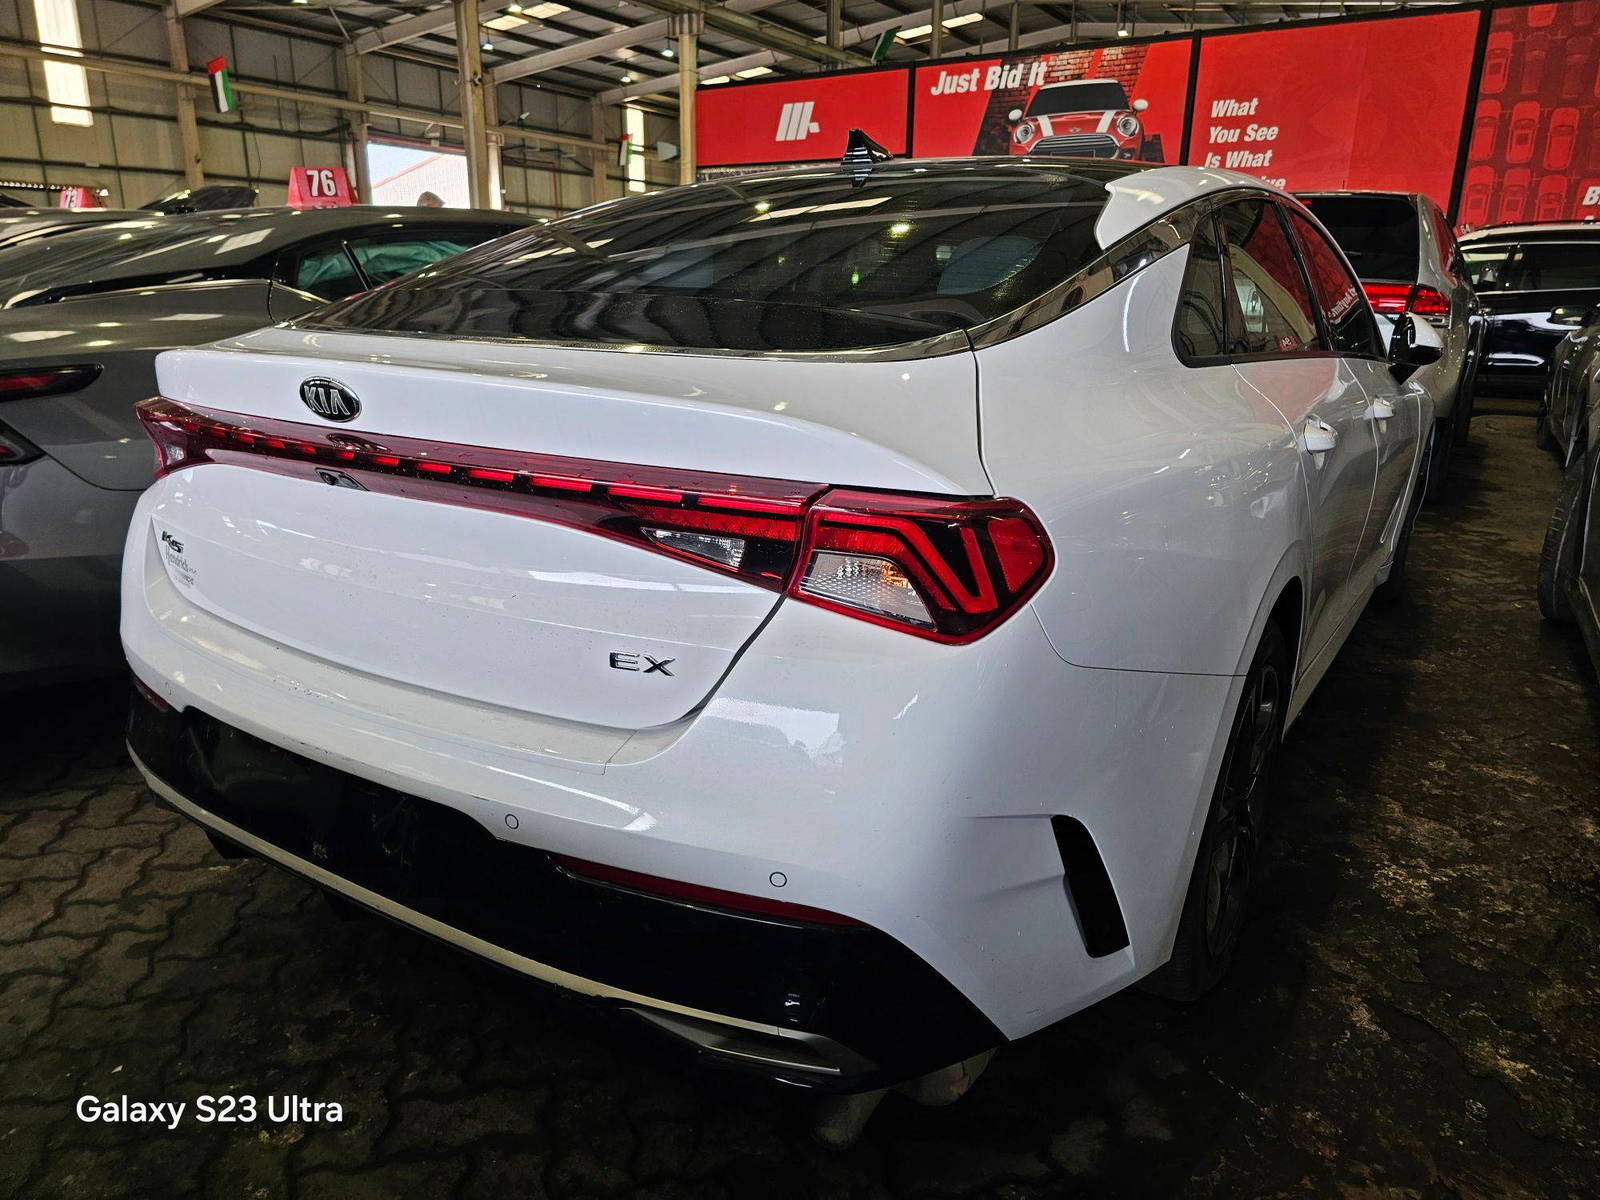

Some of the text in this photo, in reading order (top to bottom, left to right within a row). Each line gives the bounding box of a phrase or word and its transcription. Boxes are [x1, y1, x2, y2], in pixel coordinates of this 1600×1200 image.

[930, 60, 1047, 96] Just Bid It
[1211, 98, 1259, 118] What
[1209, 123, 1280, 144] You See
[1204, 149, 1273, 169] Is What
[306, 169, 337, 197] 76
[303, 385, 351, 416] KIA
[161, 530, 185, 554] K5
[609, 651, 676, 677] EX
